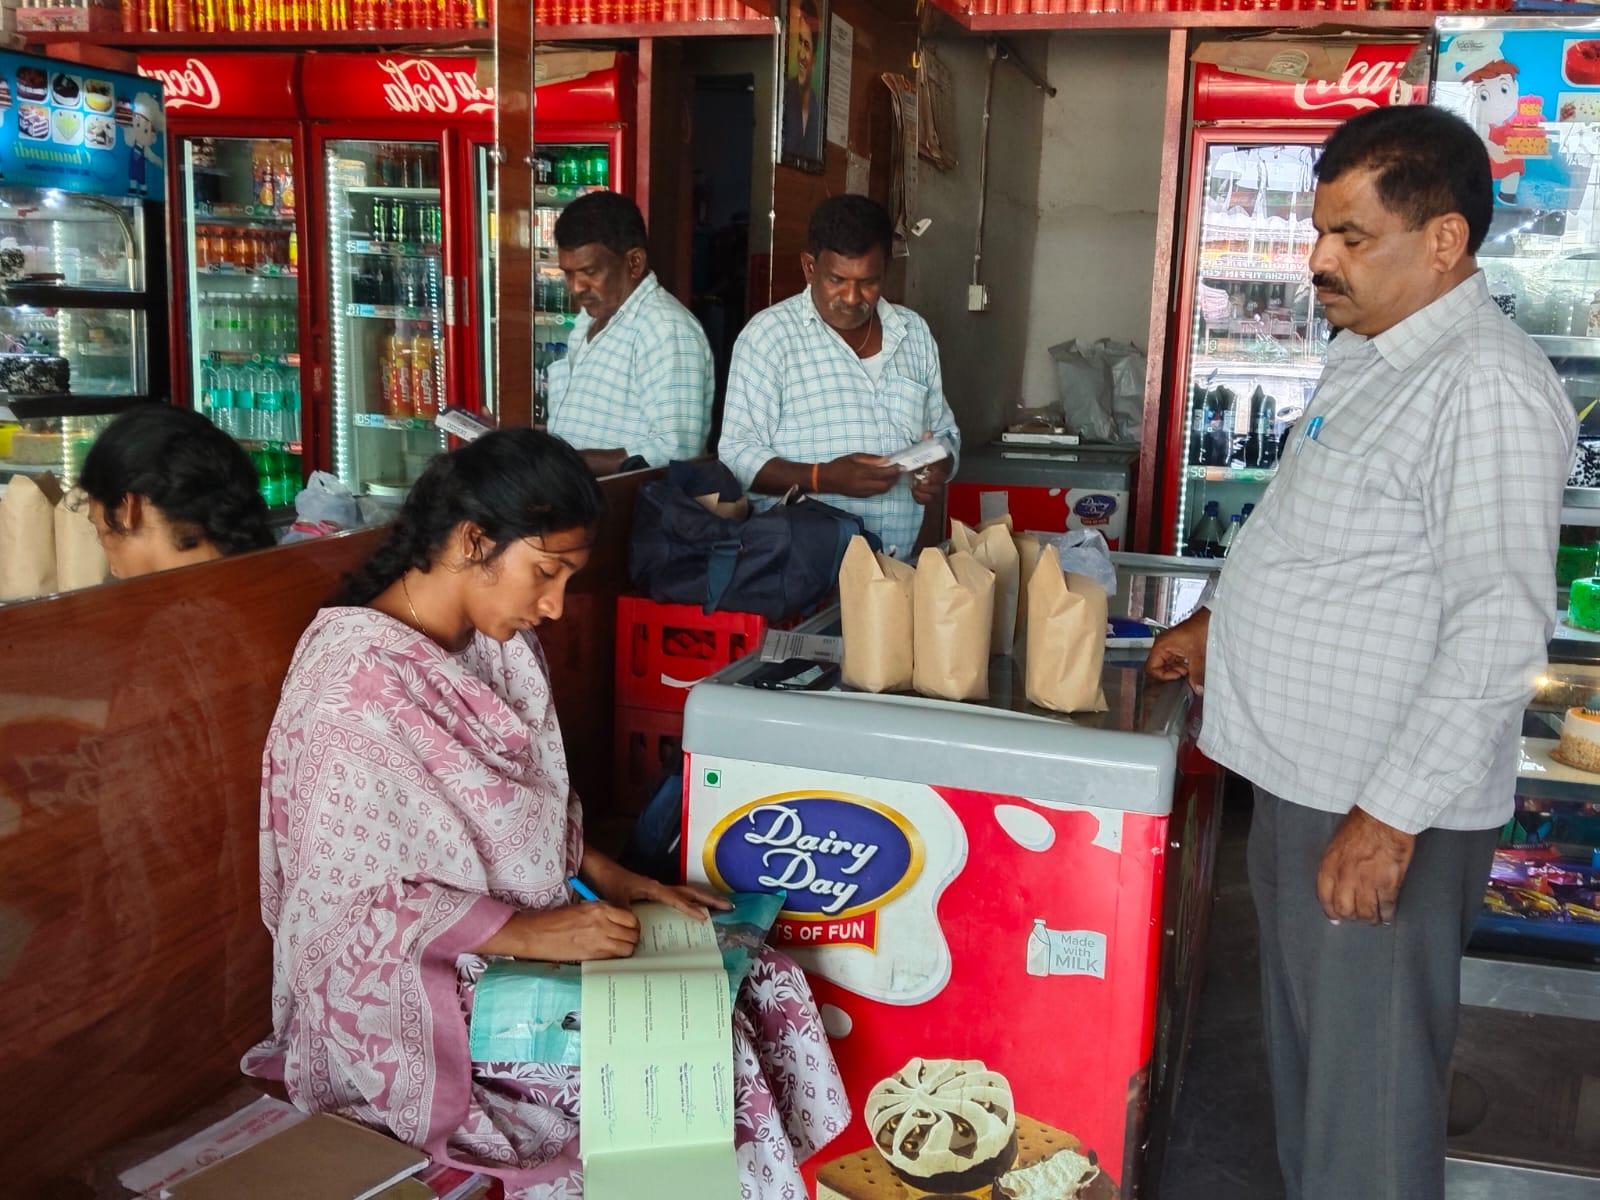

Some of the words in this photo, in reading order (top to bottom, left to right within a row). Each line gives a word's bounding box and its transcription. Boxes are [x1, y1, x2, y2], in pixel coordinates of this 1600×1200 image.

[744, 804, 879, 874] Dairy
[758, 848, 859, 914] Day
[774, 924, 793, 940] TS
[799, 925, 823, 940] OF
[828, 920, 865, 940] FUN
[1061, 934, 1096, 948] Made
[1063, 947, 1091, 958] with
[1056, 954, 1099, 973] MILK
